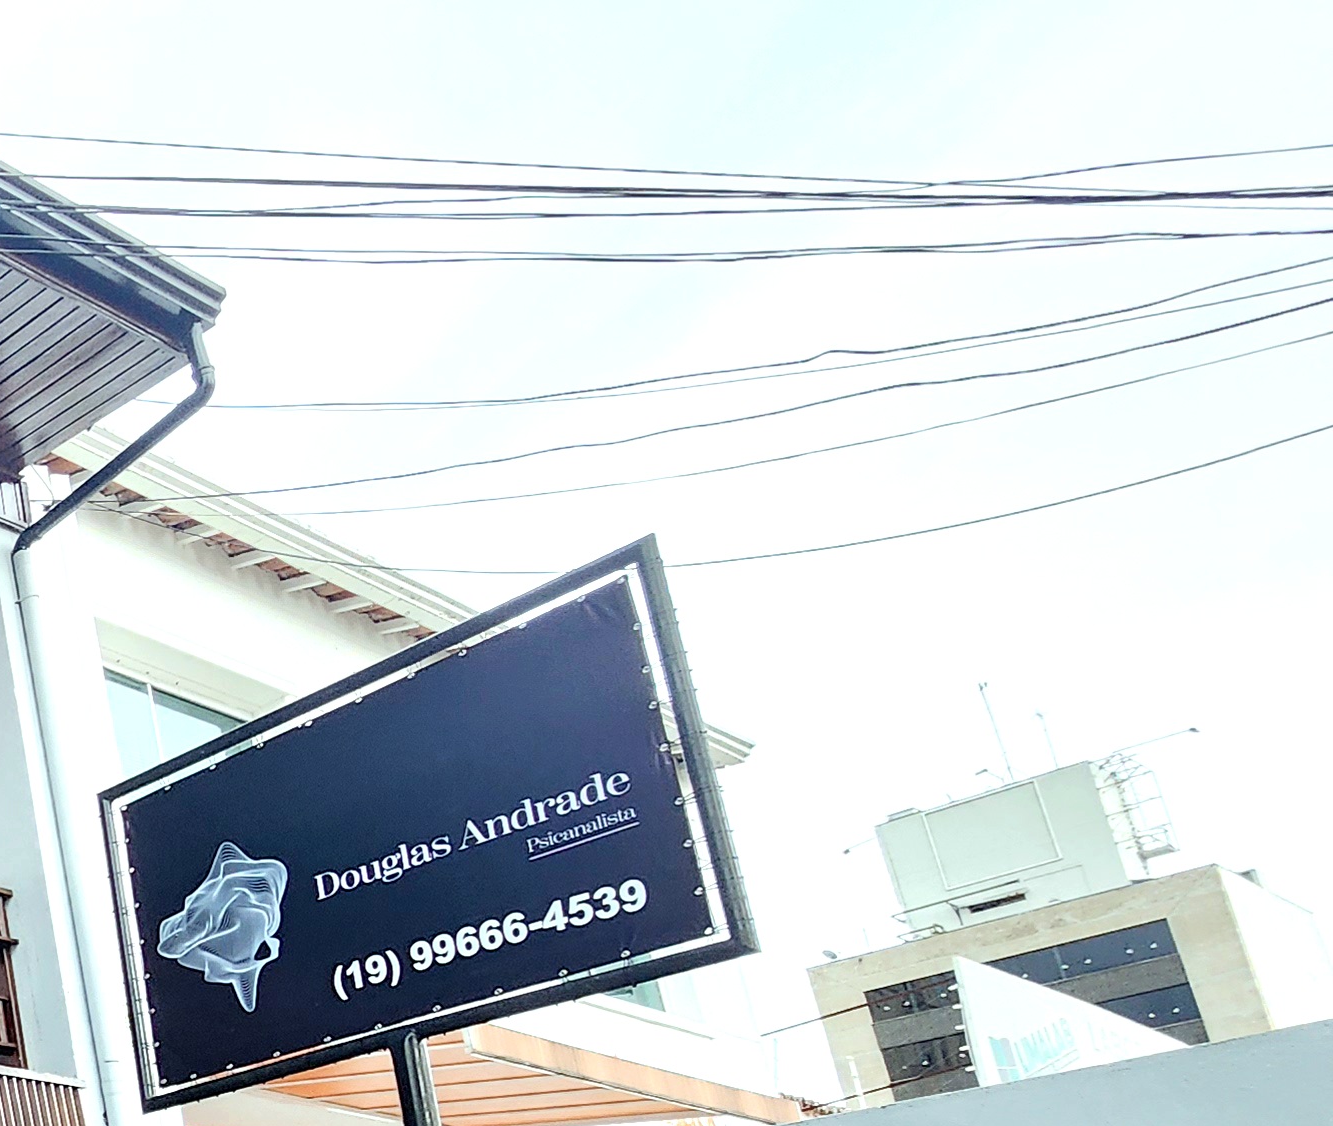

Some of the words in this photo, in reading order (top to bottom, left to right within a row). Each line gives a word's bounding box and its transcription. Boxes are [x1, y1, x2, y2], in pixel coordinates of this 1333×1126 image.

[313, 834, 452, 901] Douglas
[458, 771, 632, 850] Andrade
[526, 807, 637, 853] Psicanalista
[333, 949, 401, 1001] (19)
[409, 879, 648, 971] 99666-4539
